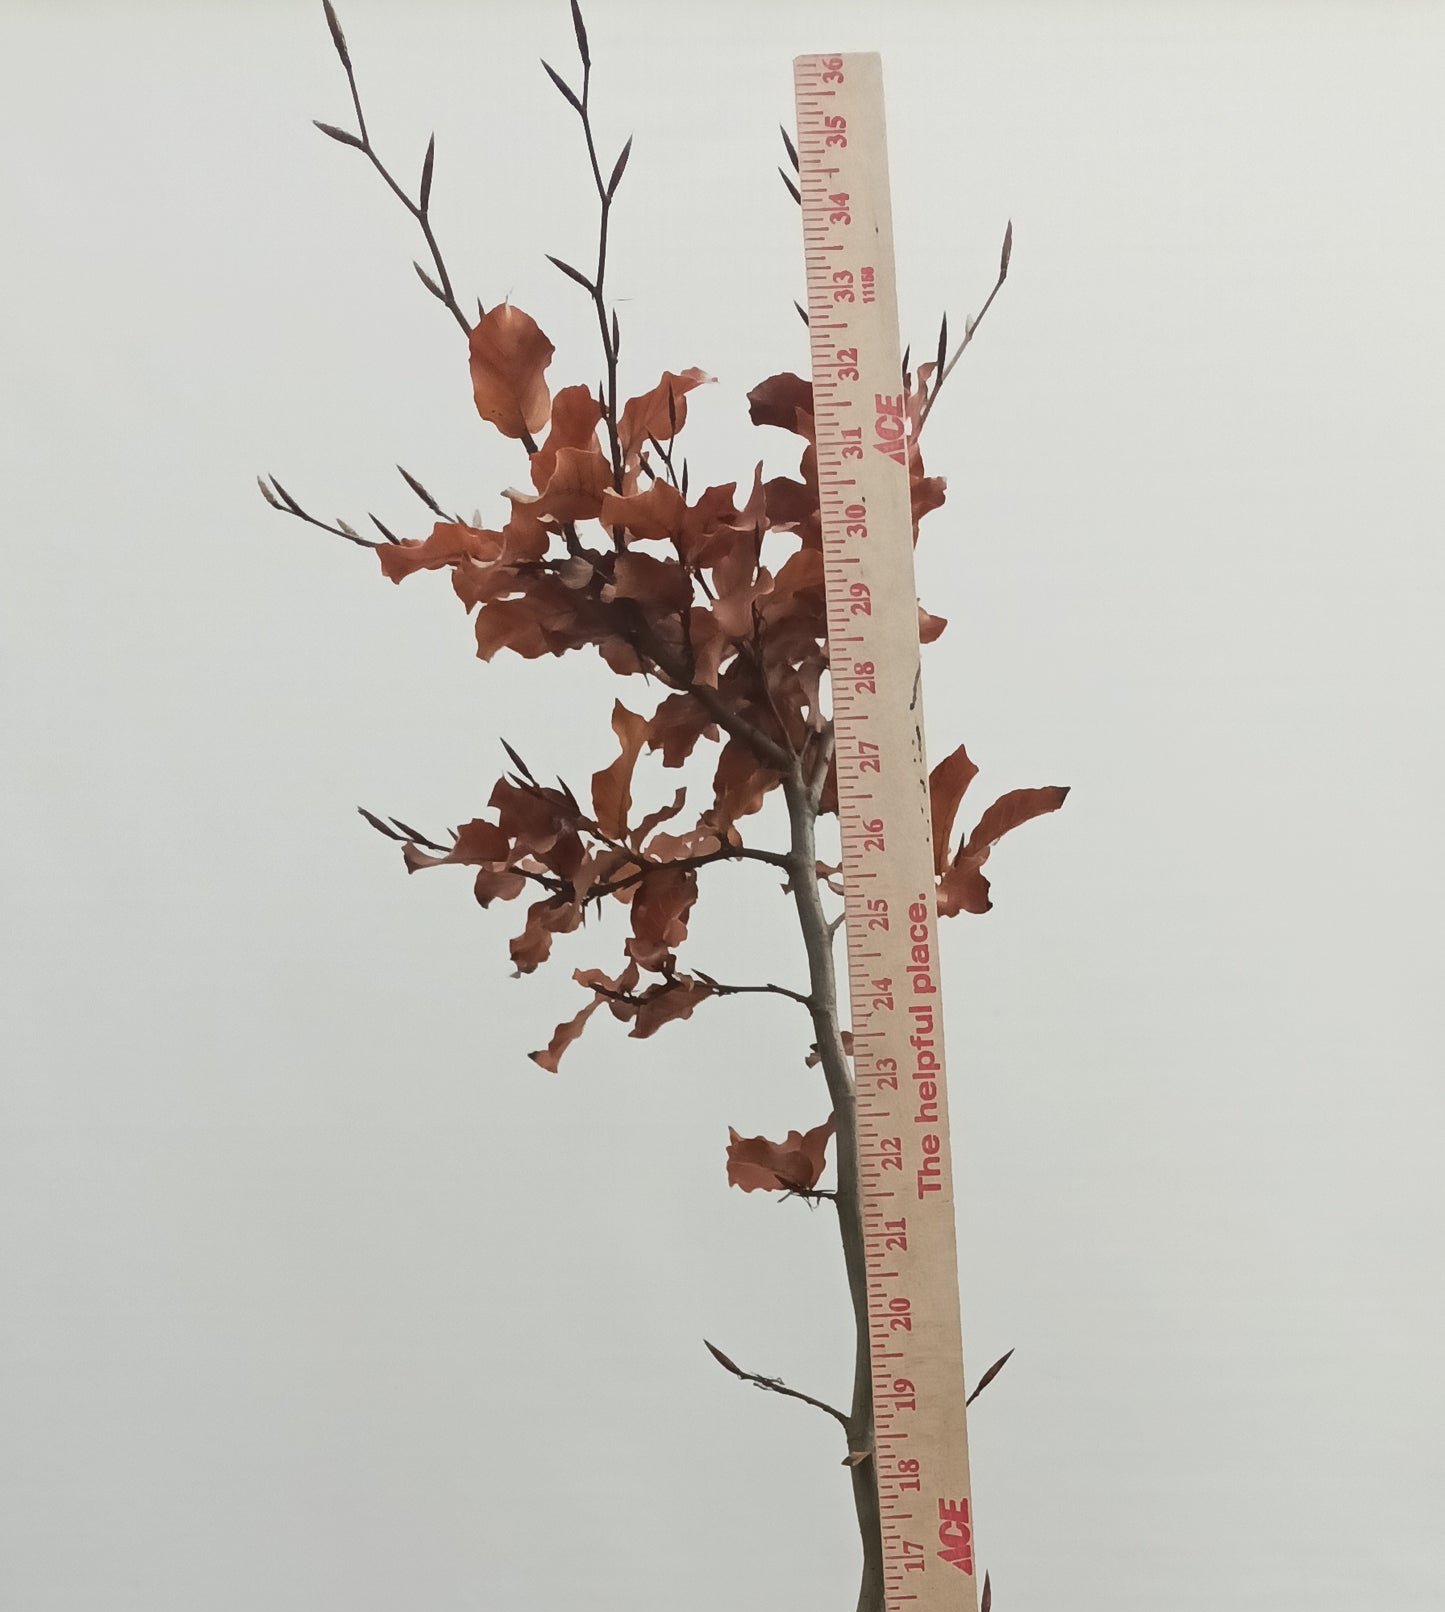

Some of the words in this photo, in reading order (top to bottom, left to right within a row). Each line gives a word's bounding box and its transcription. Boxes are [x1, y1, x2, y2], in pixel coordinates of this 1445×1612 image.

[822, 57, 844, 84] 36
[825, 116, 847, 148] 35
[828, 192, 851, 225] 34
[833, 270, 855, 303] 33
[836, 348, 859, 381] 32
[841, 426, 863, 460] 31
[872, 393, 906, 466] ACE
[845, 504, 867, 538] 30
[850, 582, 871, 616] 29
[854, 661, 876, 694] 28
[858, 741, 880, 773] 27
[862, 818, 885, 851] 26
[867, 899, 889, 931] 25
[906, 893, 937, 994] place.
[871, 977, 894, 1011] 24
[876, 1057, 898, 1090] 23
[908, 1005, 941, 1123] helpful
[880, 1137, 903, 1171] 22
[917, 1133, 942, 1200] The
[884, 1217, 908, 1251] 21
[888, 1298, 911, 1331] 20
[893, 1378, 916, 1411] 19
[897, 1459, 921, 1492] 18
[936, 1498, 973, 1576] ACE
[902, 1540, 925, 1572] 17
